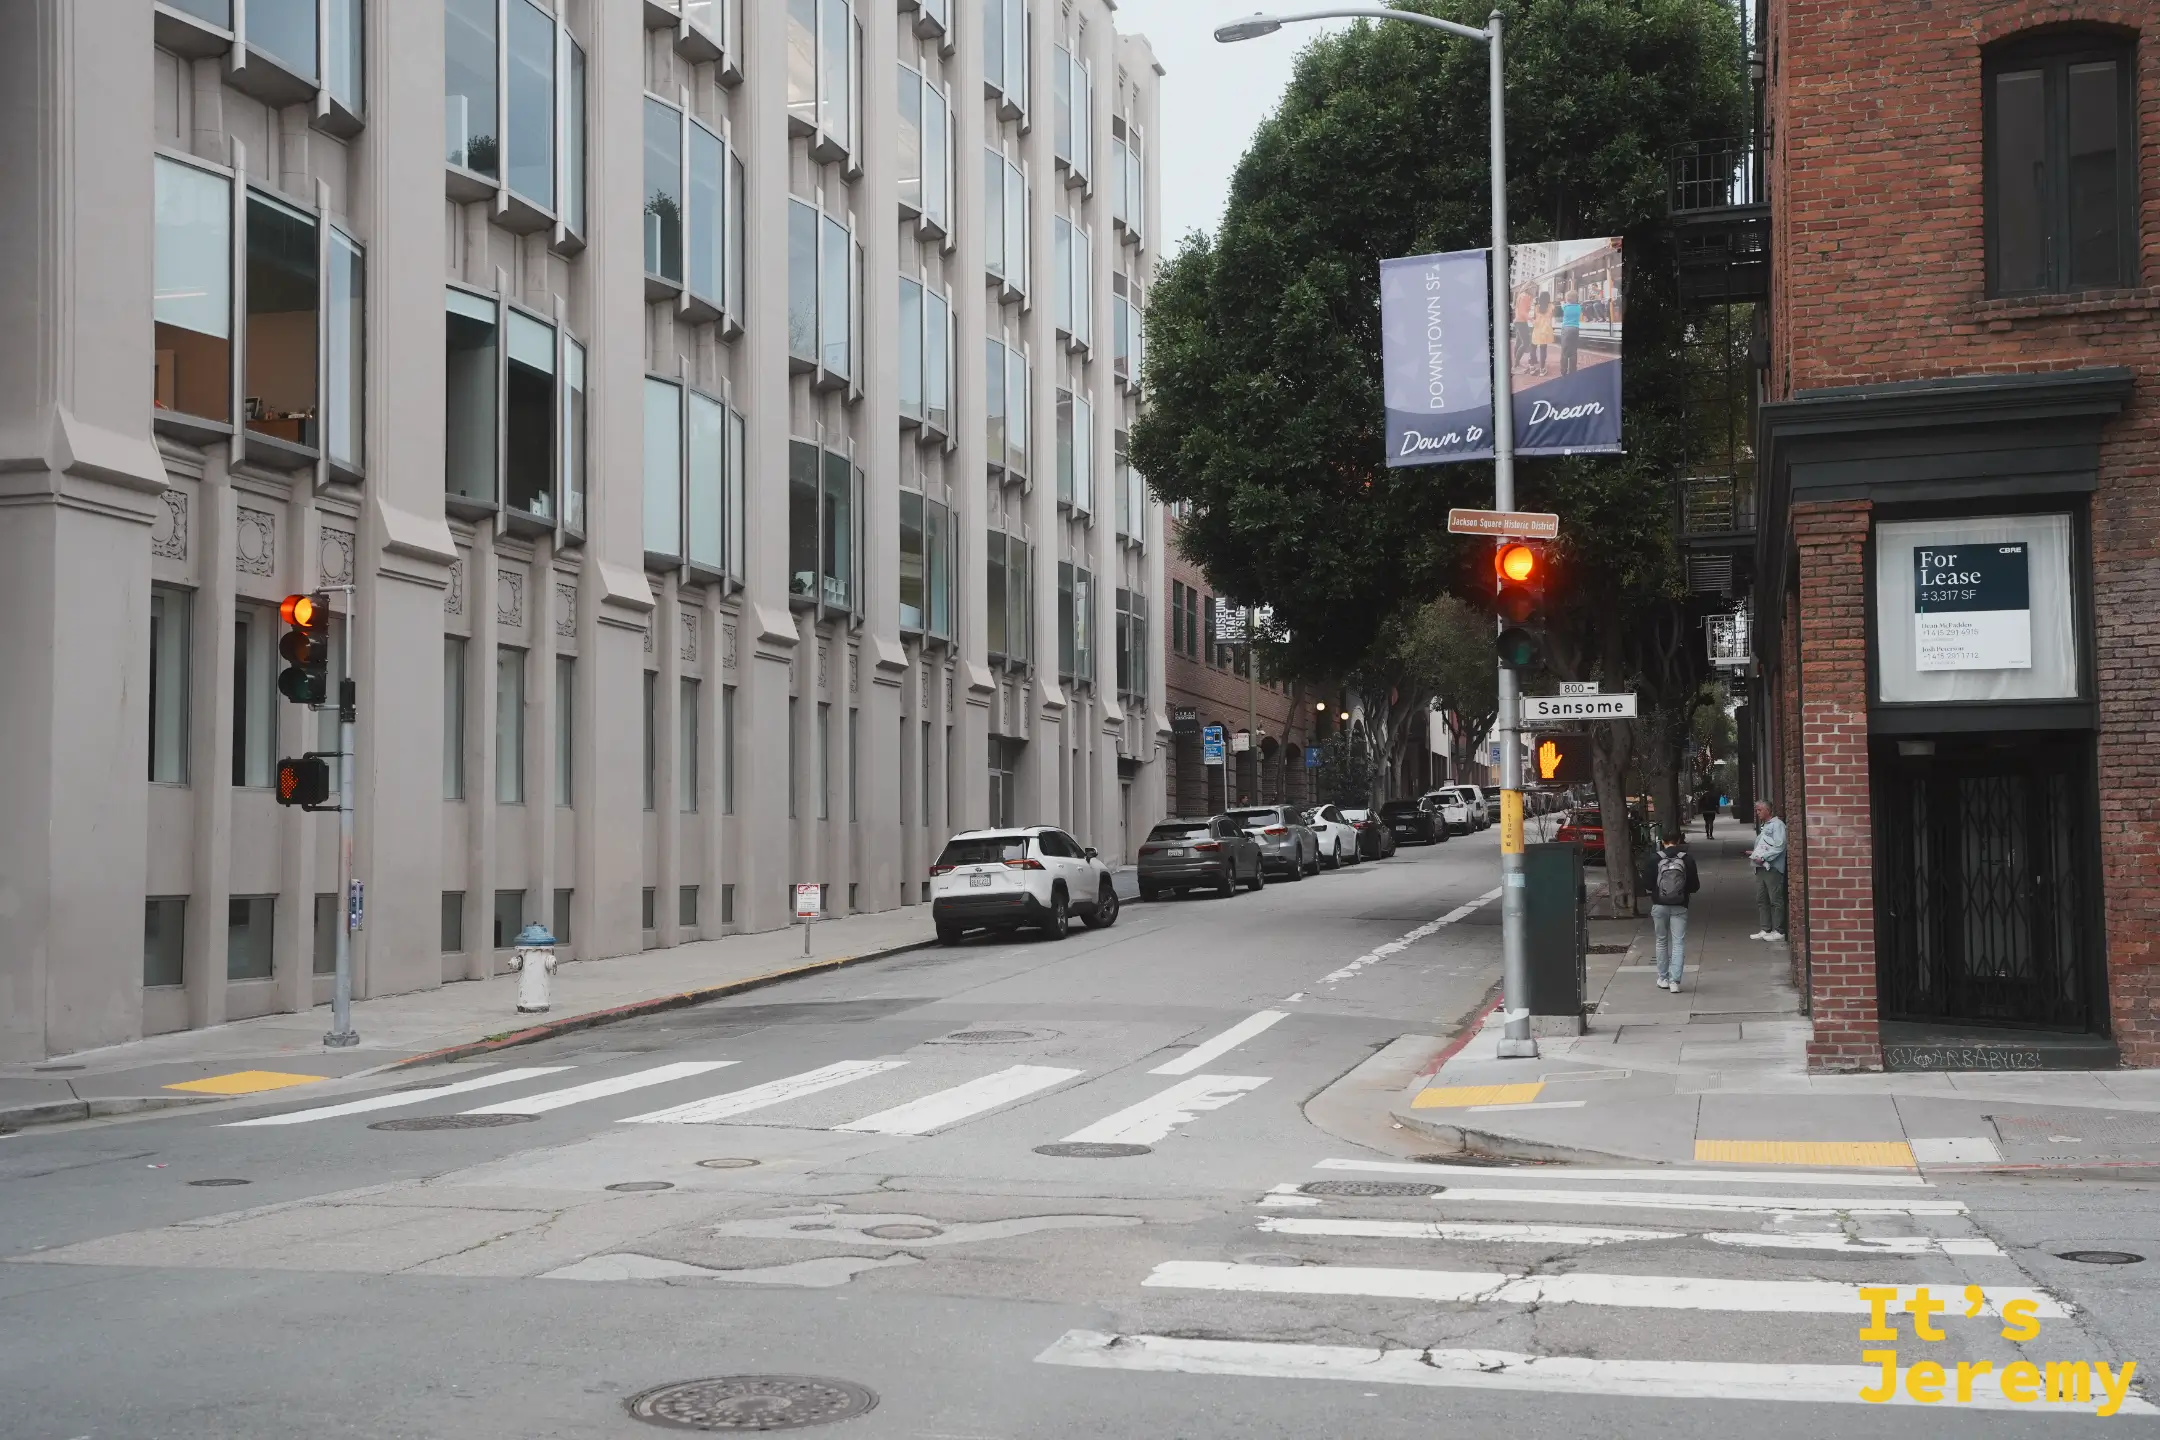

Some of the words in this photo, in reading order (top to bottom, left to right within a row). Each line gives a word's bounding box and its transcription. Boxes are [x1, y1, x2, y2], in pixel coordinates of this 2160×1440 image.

[1426, 271, 1441, 291] SF
[1427, 296, 1445, 409] DOWNTOWN
[1529, 400, 1604, 425] Dream
[1400, 430, 1460, 456] Down
[1466, 425, 1483, 441] to
[1452, 517, 1477, 526] Jackson
[1479, 518, 1502, 528] Square
[1504, 519, 1529, 529] Historic
[1531, 521, 1556, 531] District
[1920, 551, 1957, 568] For
[1920, 569, 1981, 585] Lease
[1930, 590, 1958, 602] 3,317
[1961, 589, 1977, 600] SF
[1215, 597, 1226, 640] MUSEUM
[1226, 608, 1236, 639] CRAFT
[1564, 684, 1584, 693] 800
[1538, 701, 1623, 715] Sansome
